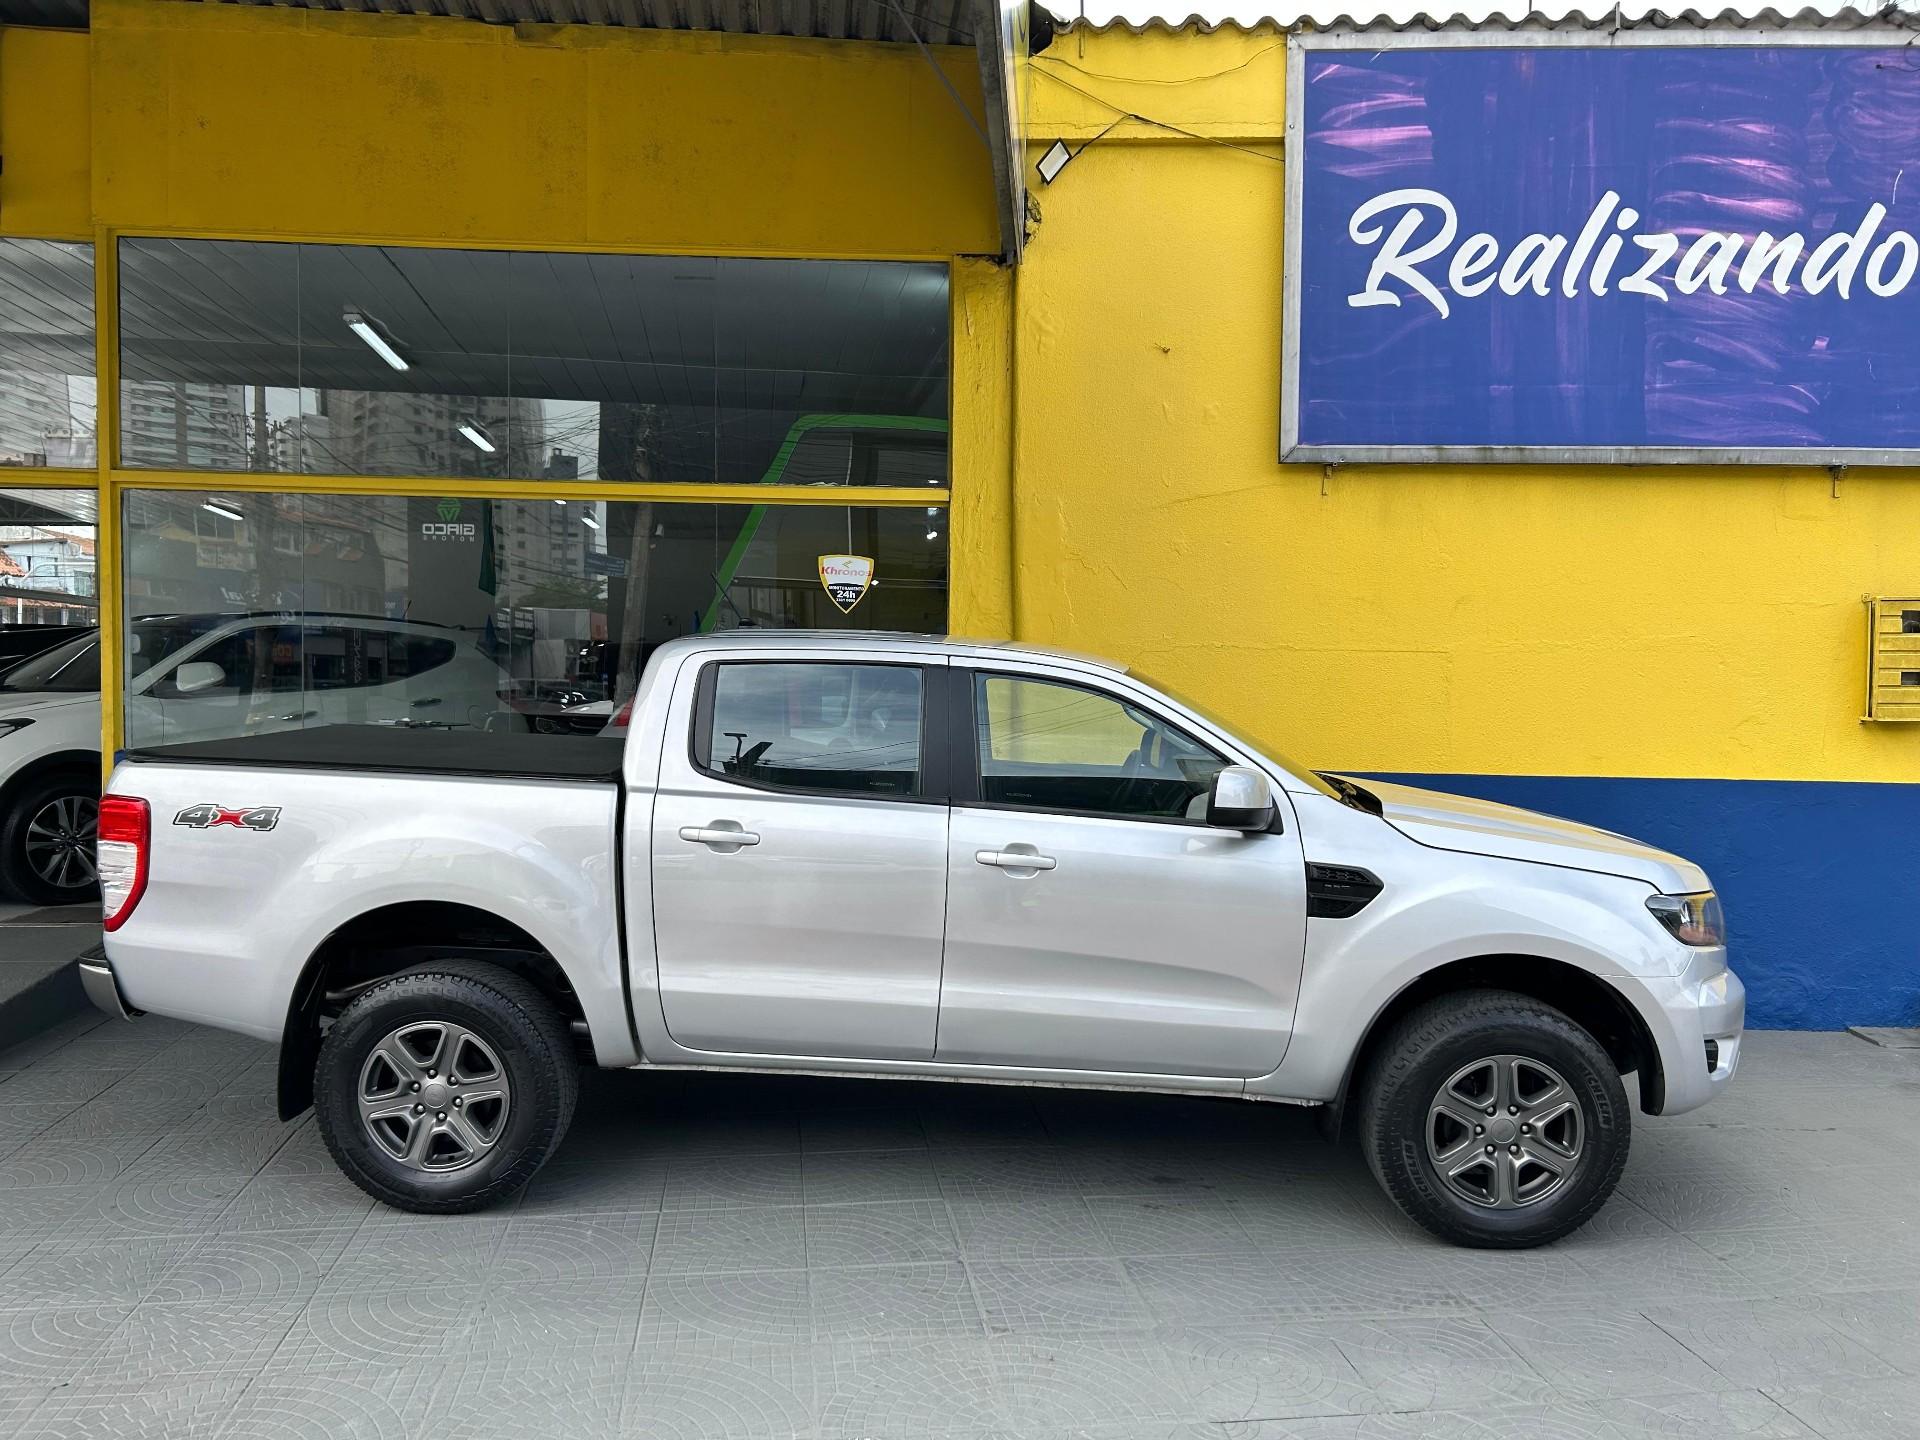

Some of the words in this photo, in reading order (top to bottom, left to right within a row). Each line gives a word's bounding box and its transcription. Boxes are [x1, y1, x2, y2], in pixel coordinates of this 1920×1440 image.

[1347, 188, 1919, 320] Realizando
[821, 566, 871, 577] Khronos
[836, 590, 856, 599] 24h
[1576, 1056, 1614, 1129] ICHELIN
[1401, 1139, 1441, 1206] ICHELIN
